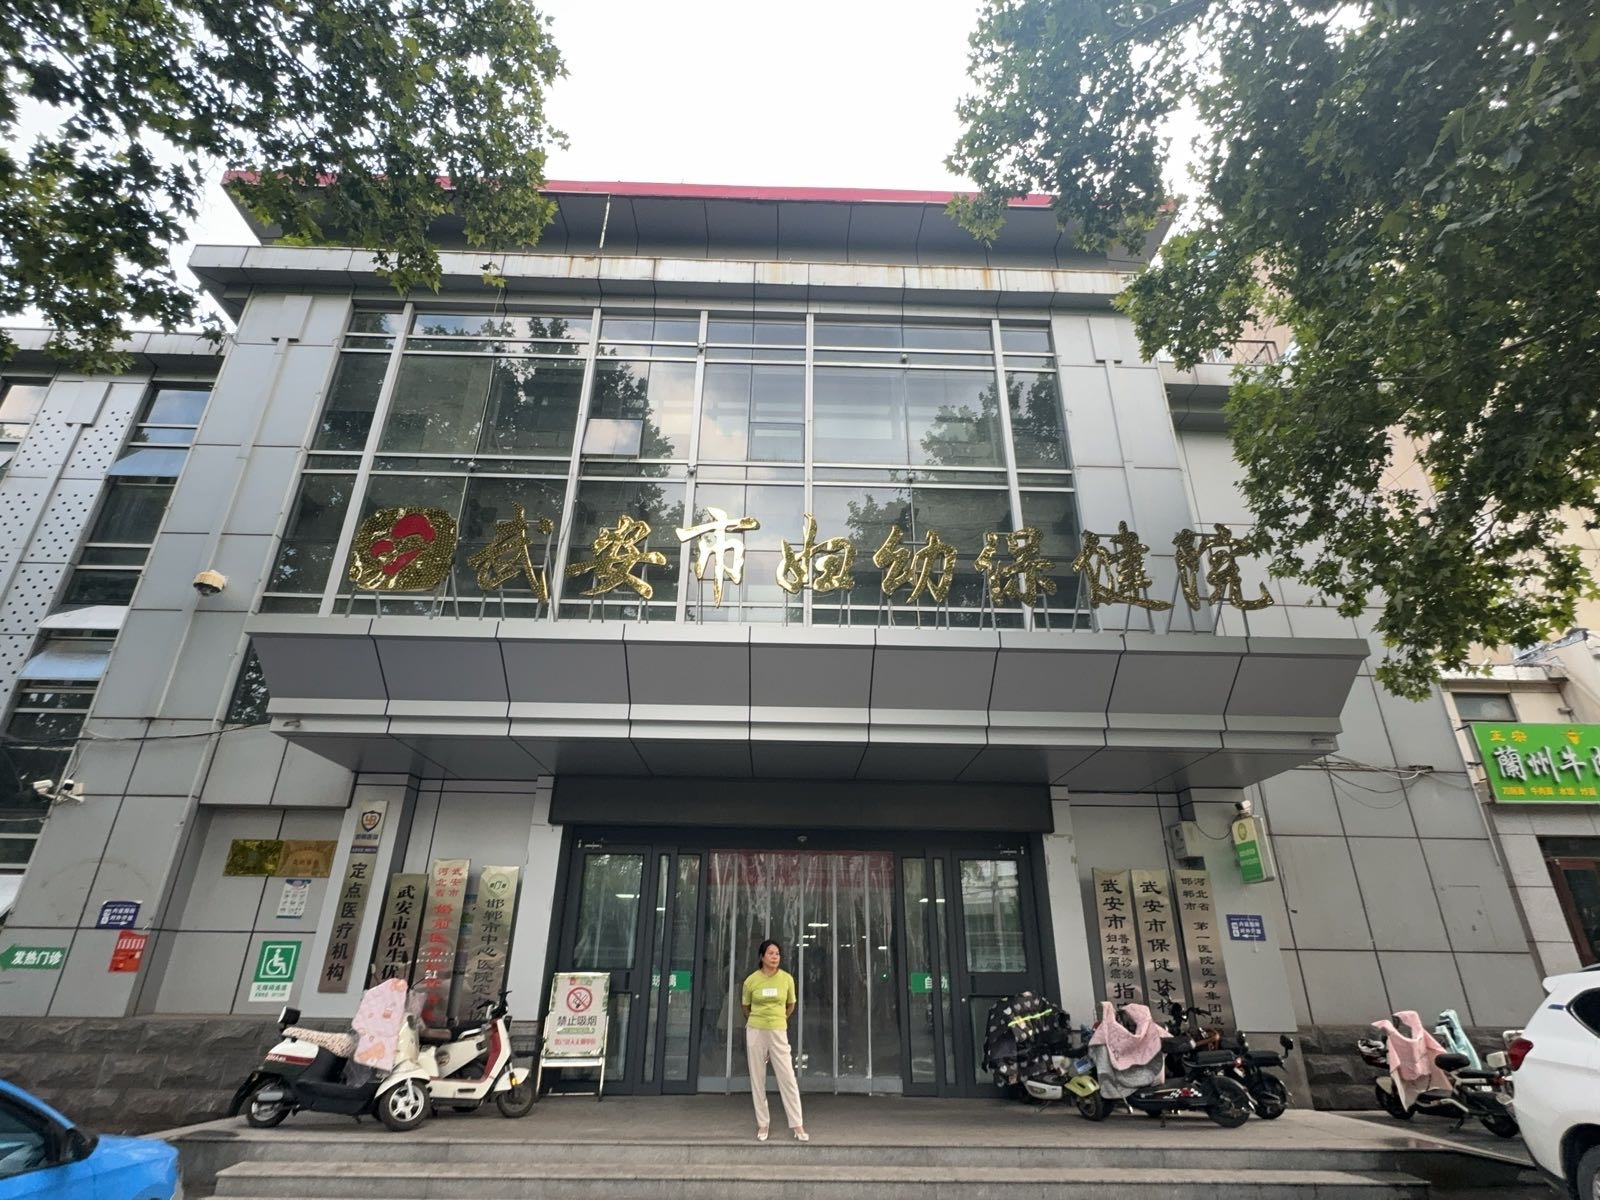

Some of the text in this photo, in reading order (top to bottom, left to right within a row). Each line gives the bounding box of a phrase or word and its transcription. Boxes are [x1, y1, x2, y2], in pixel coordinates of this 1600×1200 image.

[467, 501, 1275, 611] 武安市妇幼保健院
[326, 862, 368, 982] 定点医疗机构
[1101, 879, 1126, 929] 武安市
[11, 950, 63, 966] 发热门诊
[557, 1015, 597, 1026] 禁止吸烟
